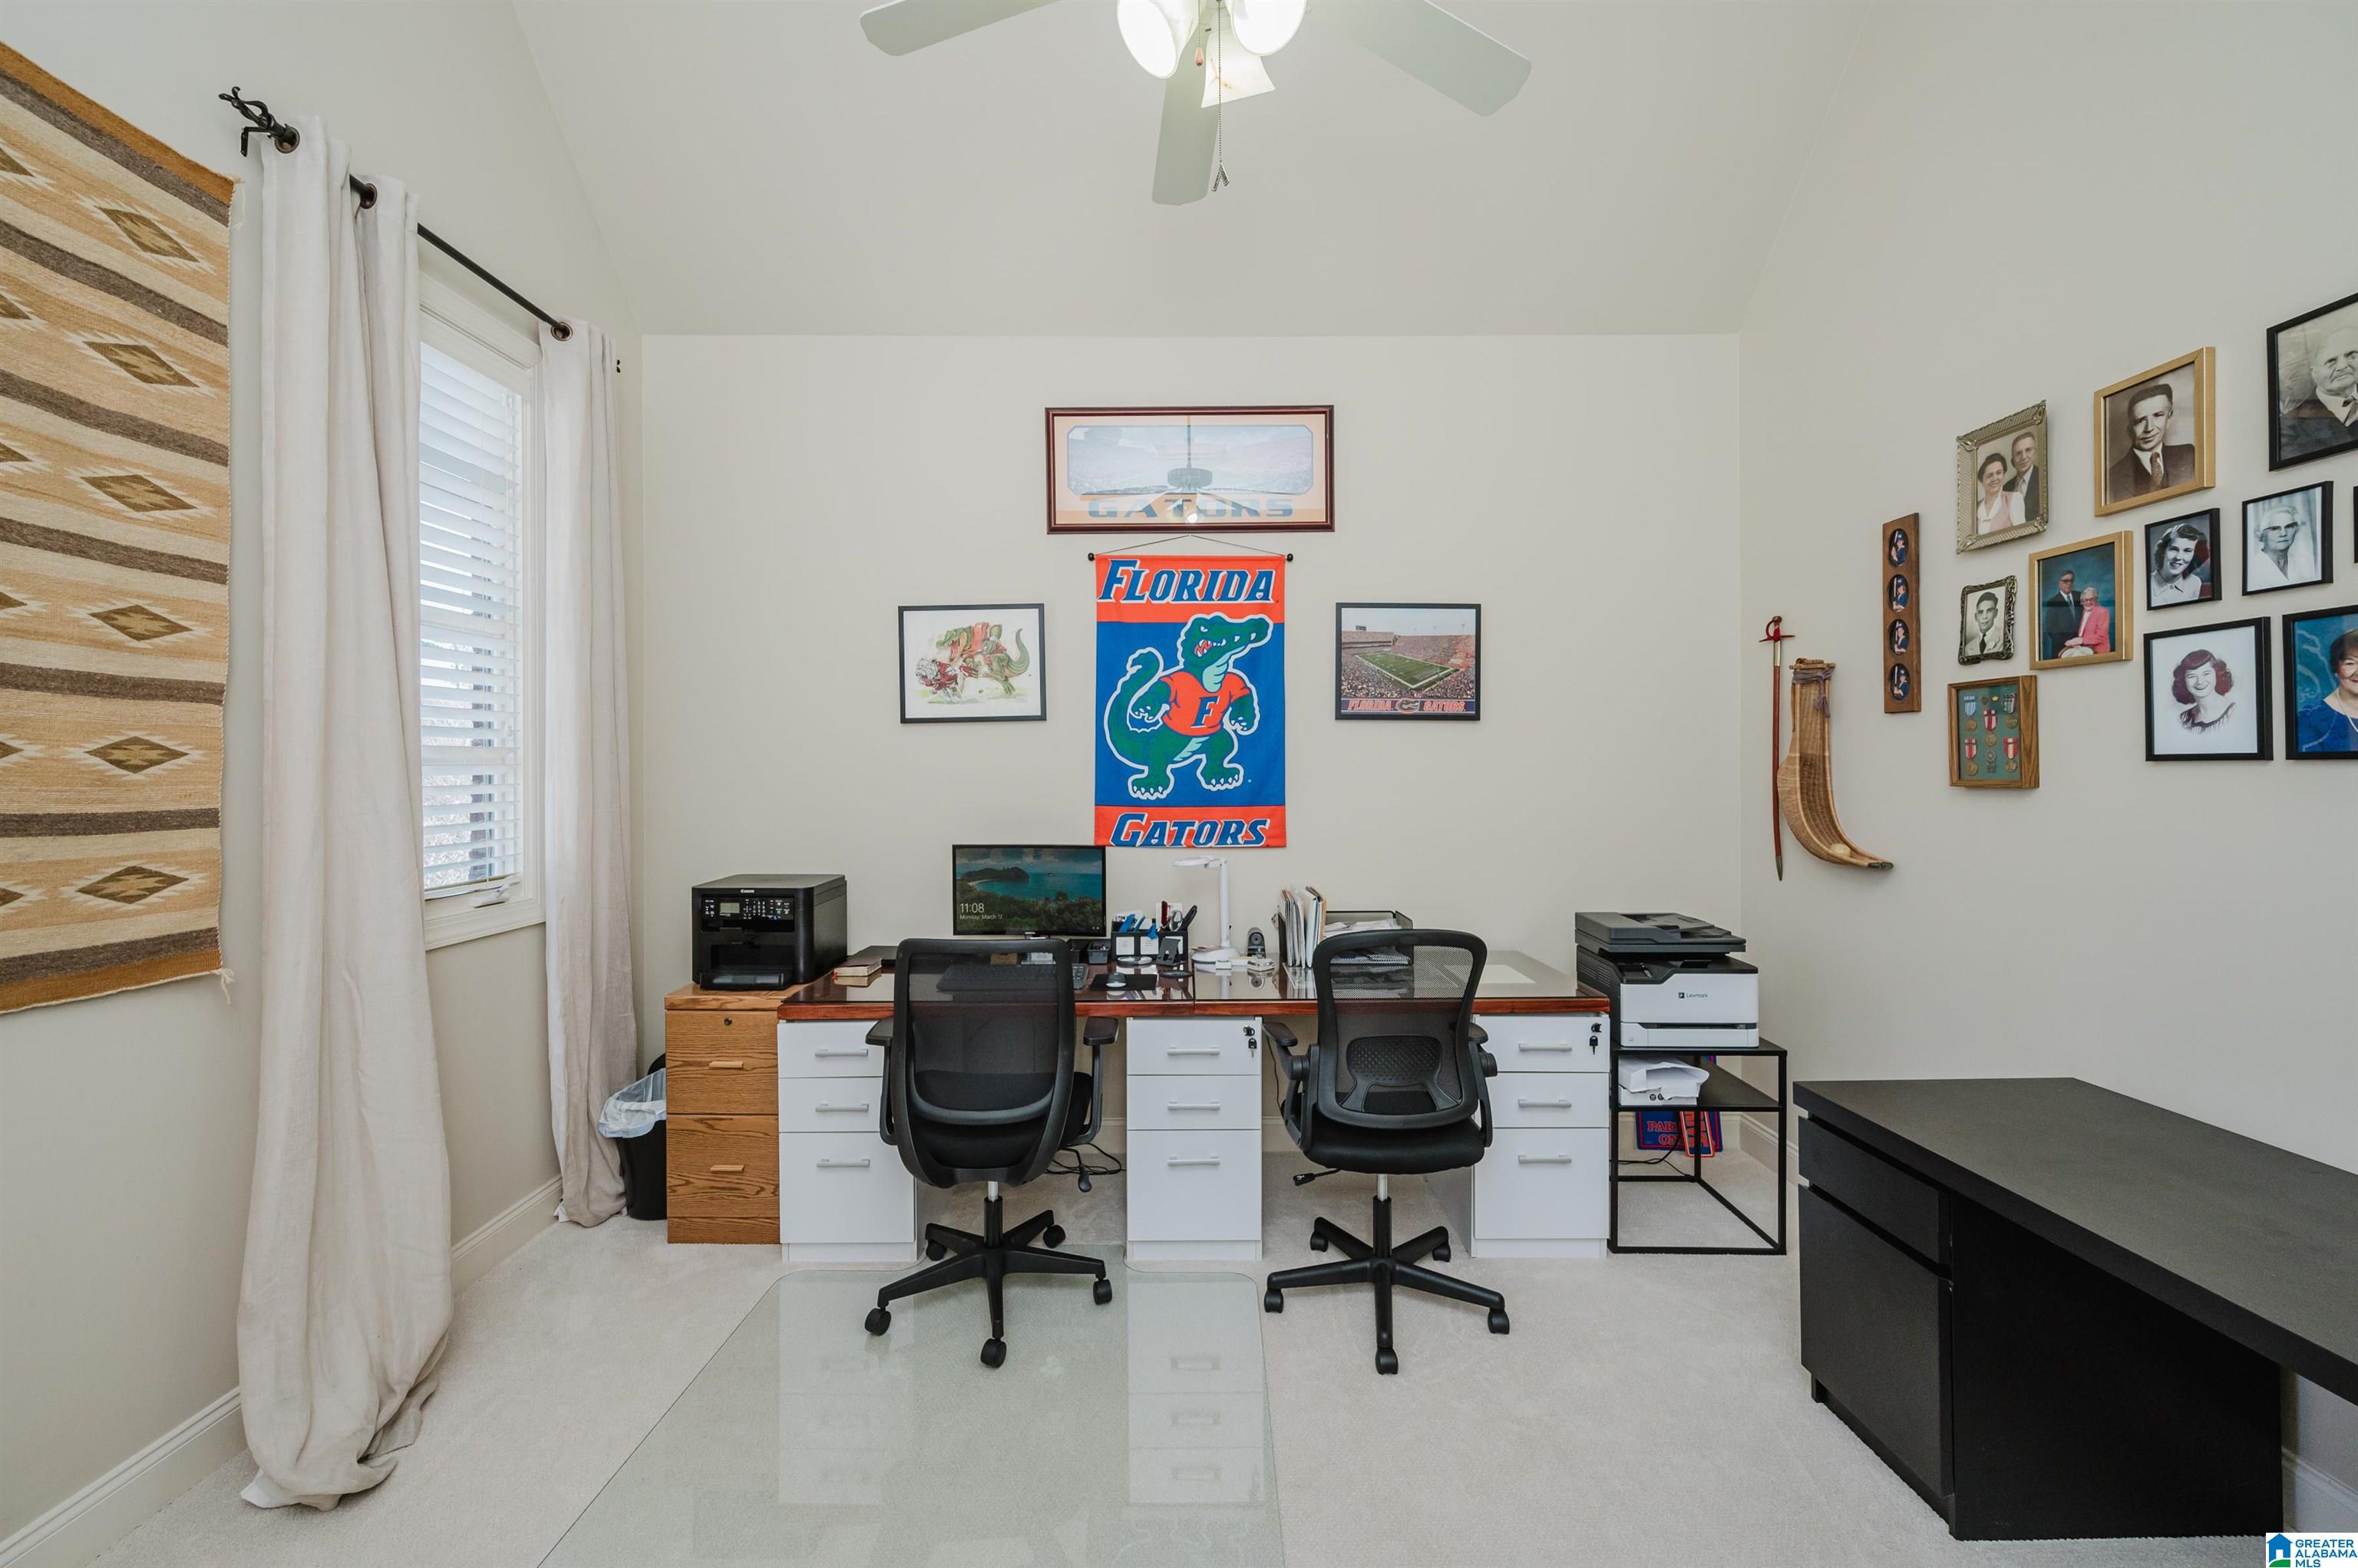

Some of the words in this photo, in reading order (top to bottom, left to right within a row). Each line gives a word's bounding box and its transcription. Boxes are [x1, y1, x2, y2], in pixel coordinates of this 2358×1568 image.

[1088, 498, 1293, 518] GATORS
[1096, 559, 1276, 604] FLORIDA
[1191, 695, 1221, 729] F
[1347, 700, 1392, 711] FLORIDA
[1422, 701, 1465, 711] GATORS
[1110, 812, 1270, 847] GATORS
[959, 903, 985, 913] 11:08
